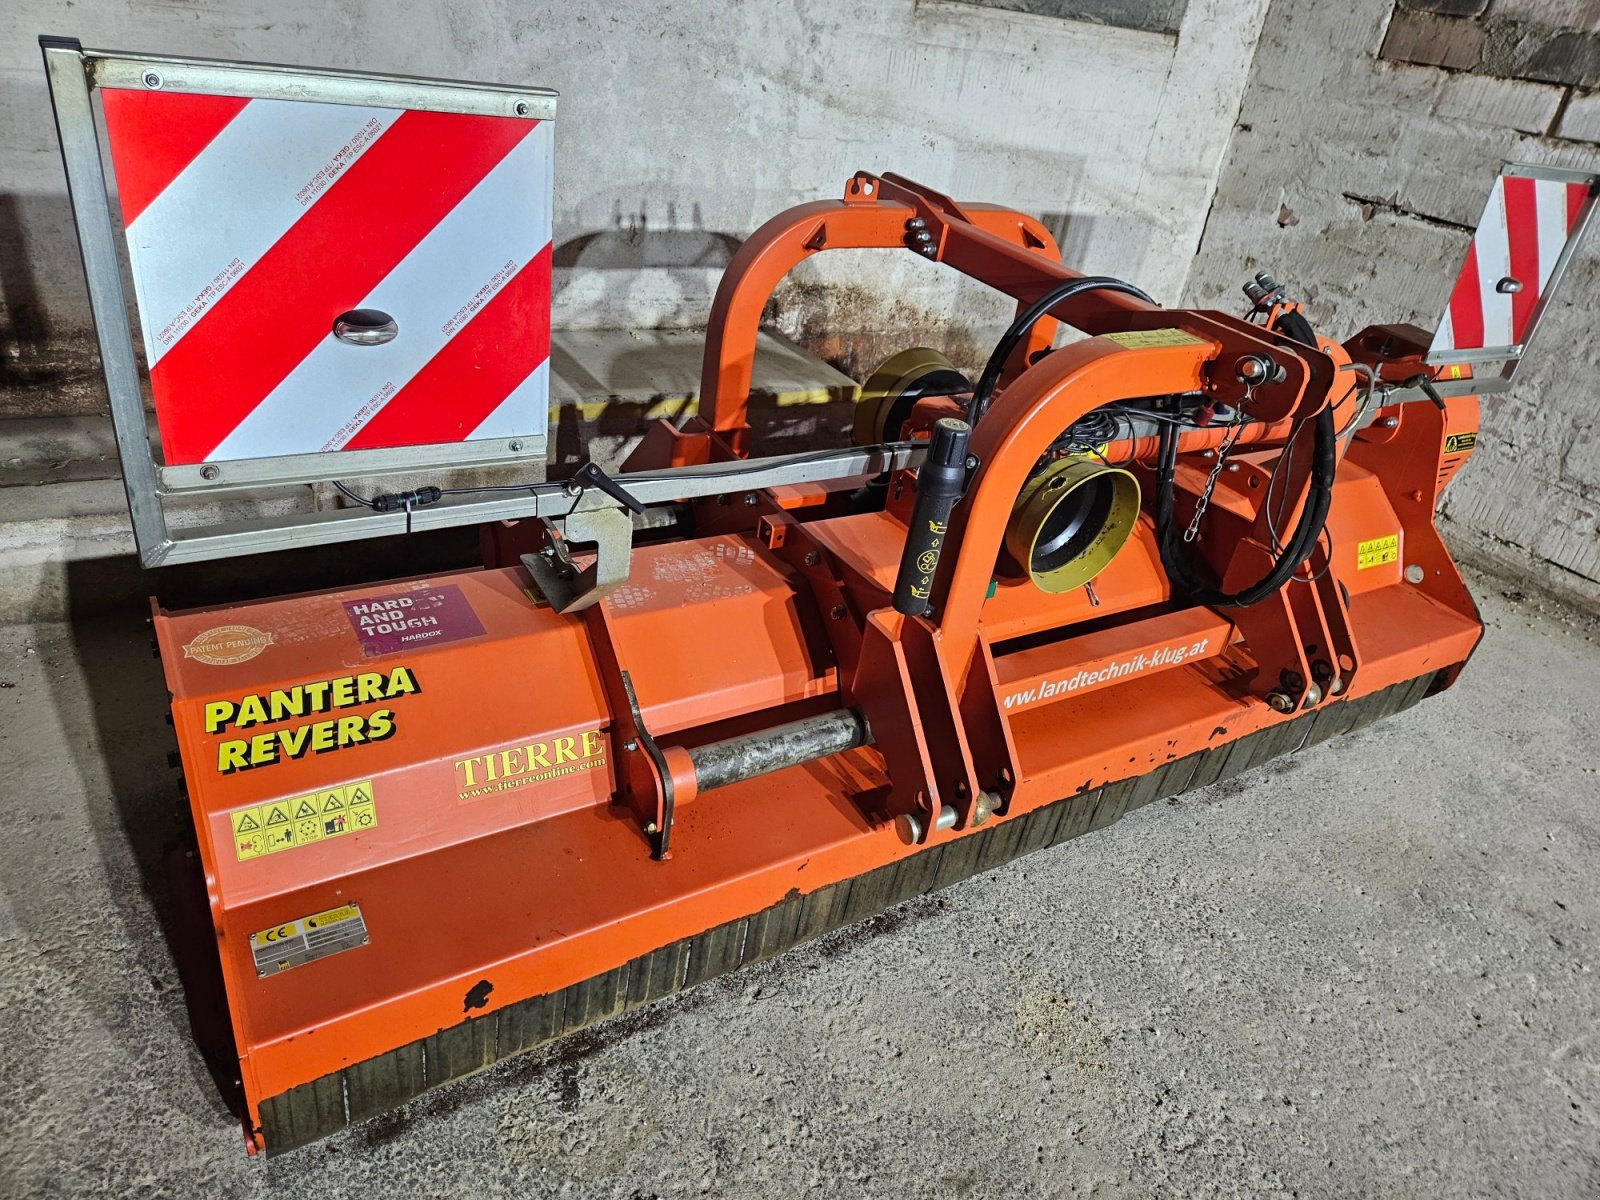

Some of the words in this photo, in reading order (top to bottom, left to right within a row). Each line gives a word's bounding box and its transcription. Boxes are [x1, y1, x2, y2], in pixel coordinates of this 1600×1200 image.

[367, 117, 378, 129] DIN
[352, 129, 366, 144] 11030
[333, 146, 350, 161] GEKA
[301, 195, 312, 206] DIN
[312, 180, 326, 195] 11030
[329, 162, 344, 178] GEKA
[346, 152, 353, 161] TP
[353, 137, 370, 153] ESC-A
[368, 123, 383, 138] 06021
[325, 164, 332, 172] TP
[308, 171, 325, 187] ESC-A
[295, 185, 309, 201] 06021
[195, 286, 212, 301] GEKA
[191, 301, 208, 317] GEKA
[353, 598, 413, 615] HARD
[360, 610, 404, 626] AND
[362, 615, 438, 636] TOUGH
[401, 630, 442, 642] HARDOX
[190, 643, 224, 654] PATENT
[226, 636, 267, 649] PENDING
[204, 666, 422, 735] PANTERA
[217, 709, 397, 775] REVERS
[454, 728, 604, 787] TIERRE
[458, 757, 606, 800] www.tierreonline.com
